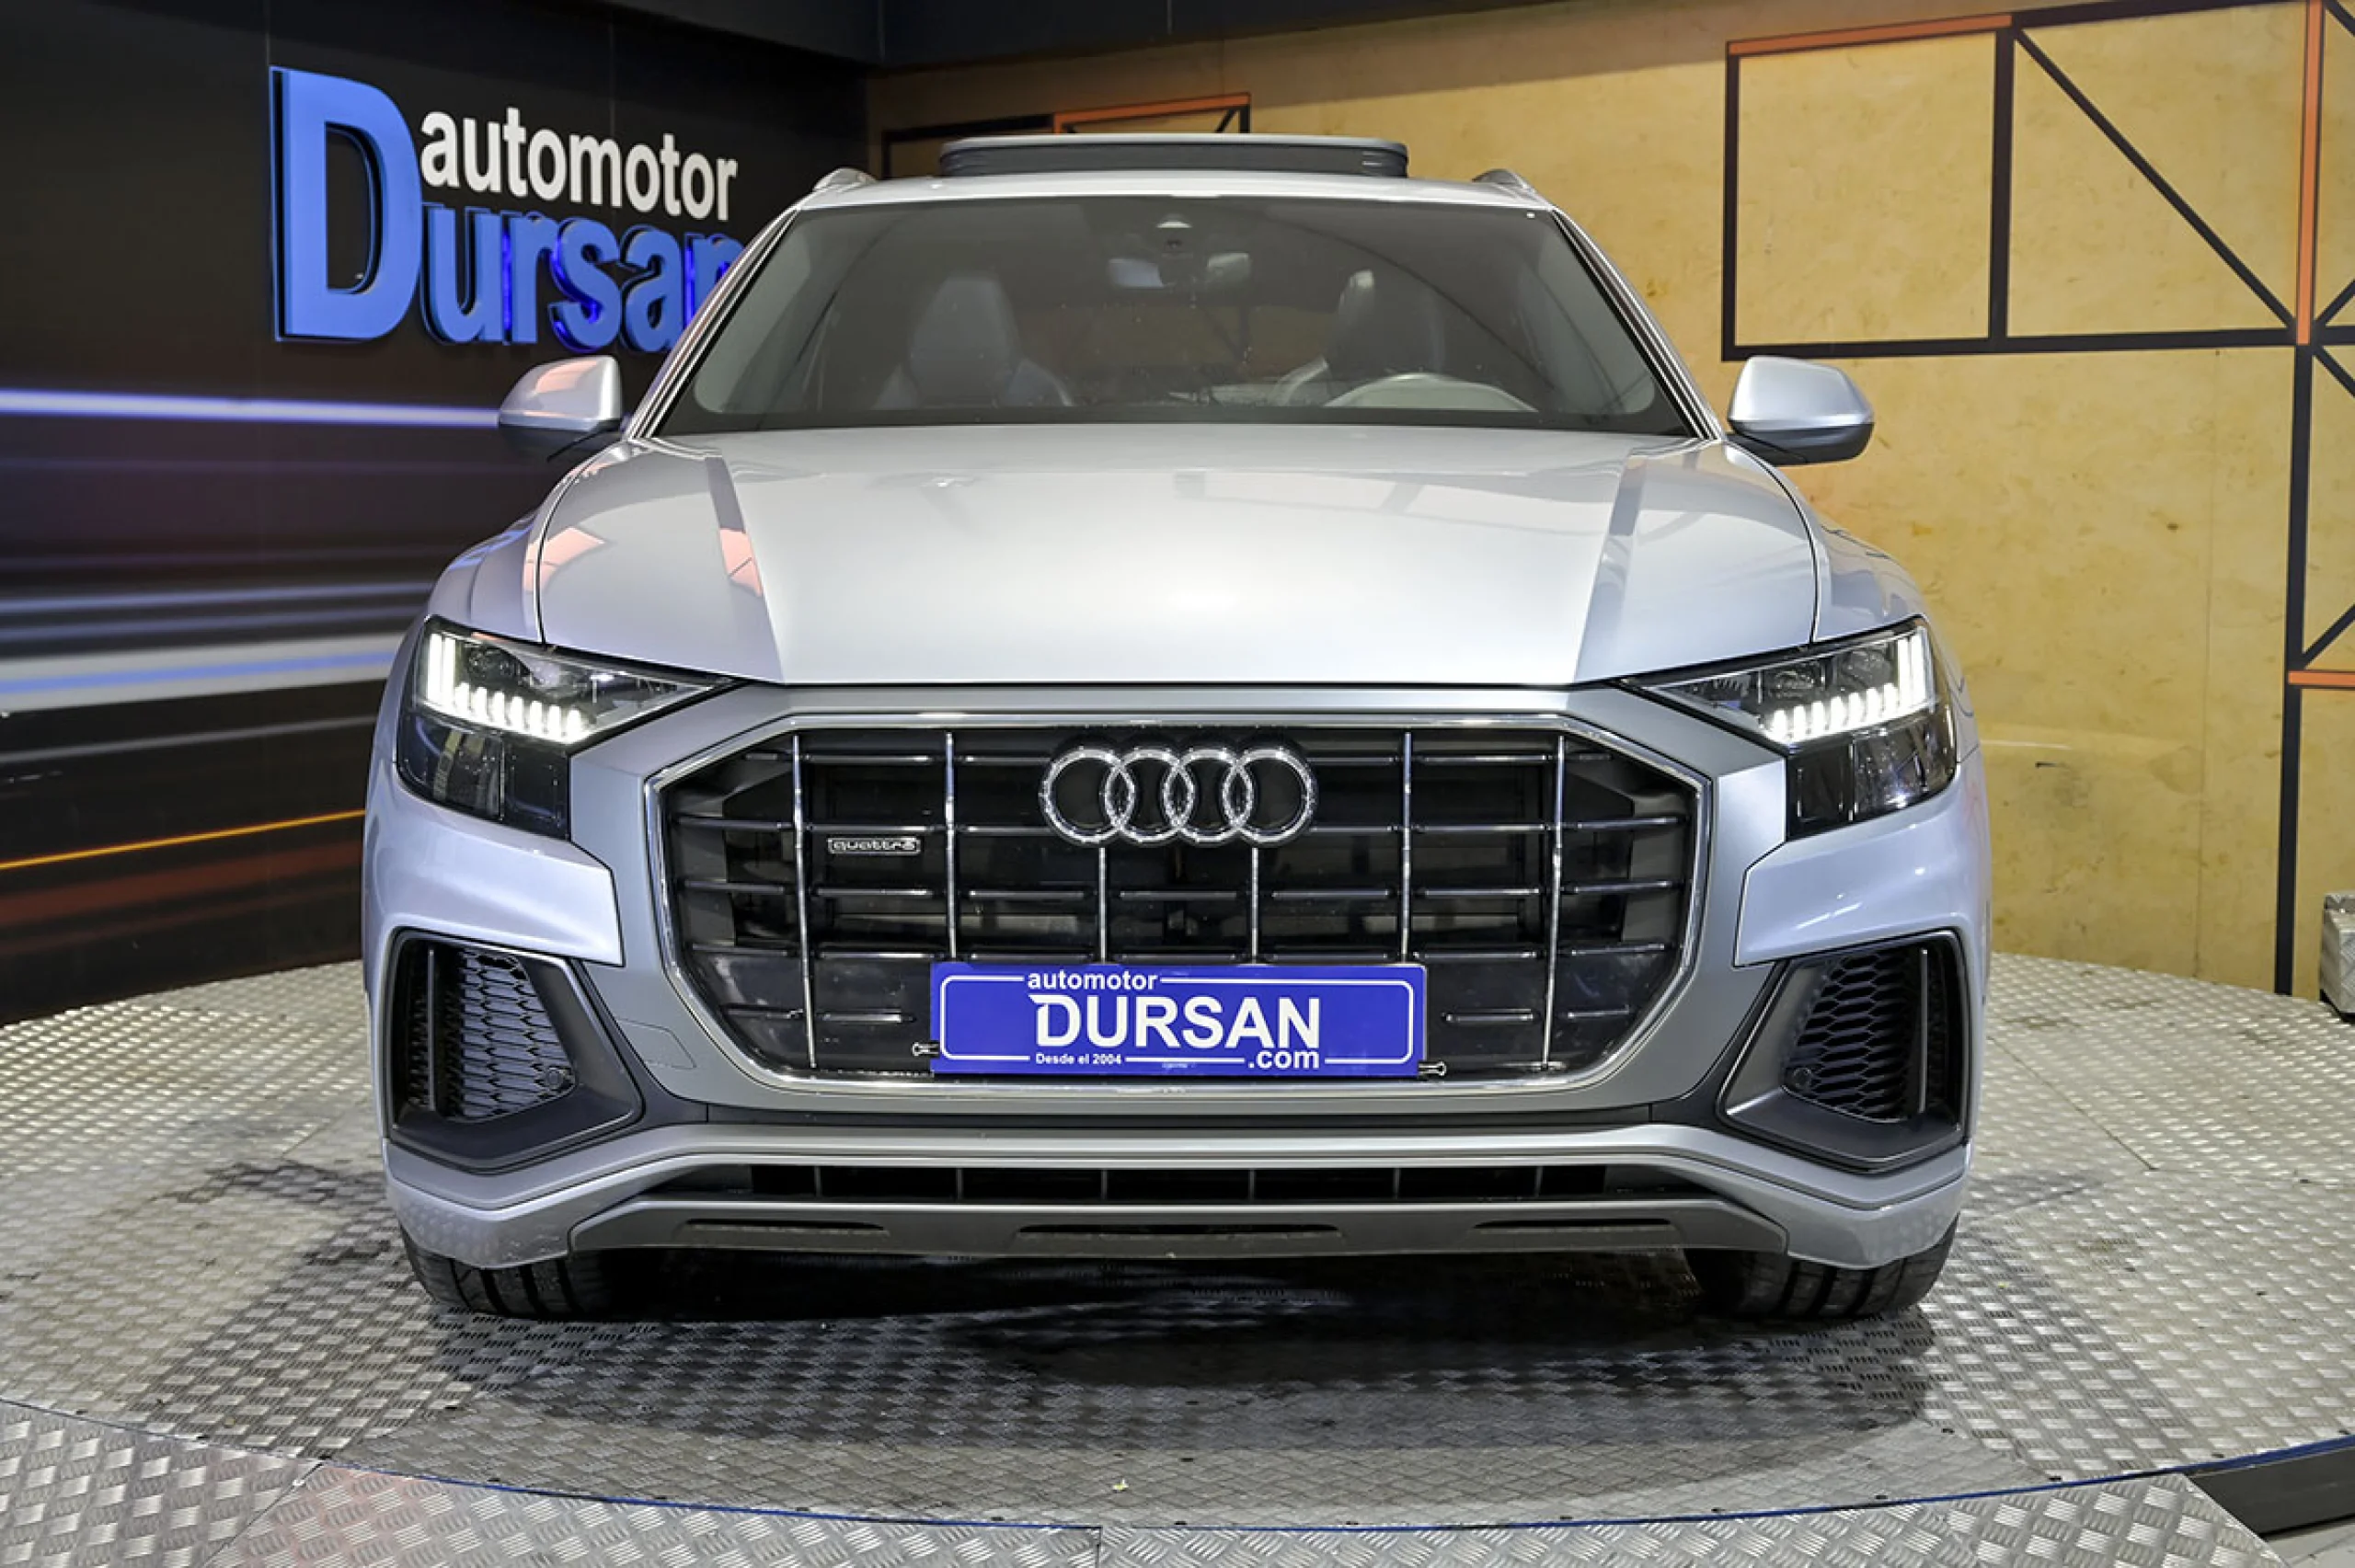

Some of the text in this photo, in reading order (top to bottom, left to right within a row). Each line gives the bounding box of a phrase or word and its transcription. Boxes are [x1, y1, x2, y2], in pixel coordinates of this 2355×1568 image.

[420, 107, 738, 222] automotor
[1028, 969, 1158, 990] automotor
[1028, 994, 1319, 1049] DURSAN
[1036, 1052, 1122, 1065] Desde el 2004
[1247, 1047, 1319, 1070] .com
